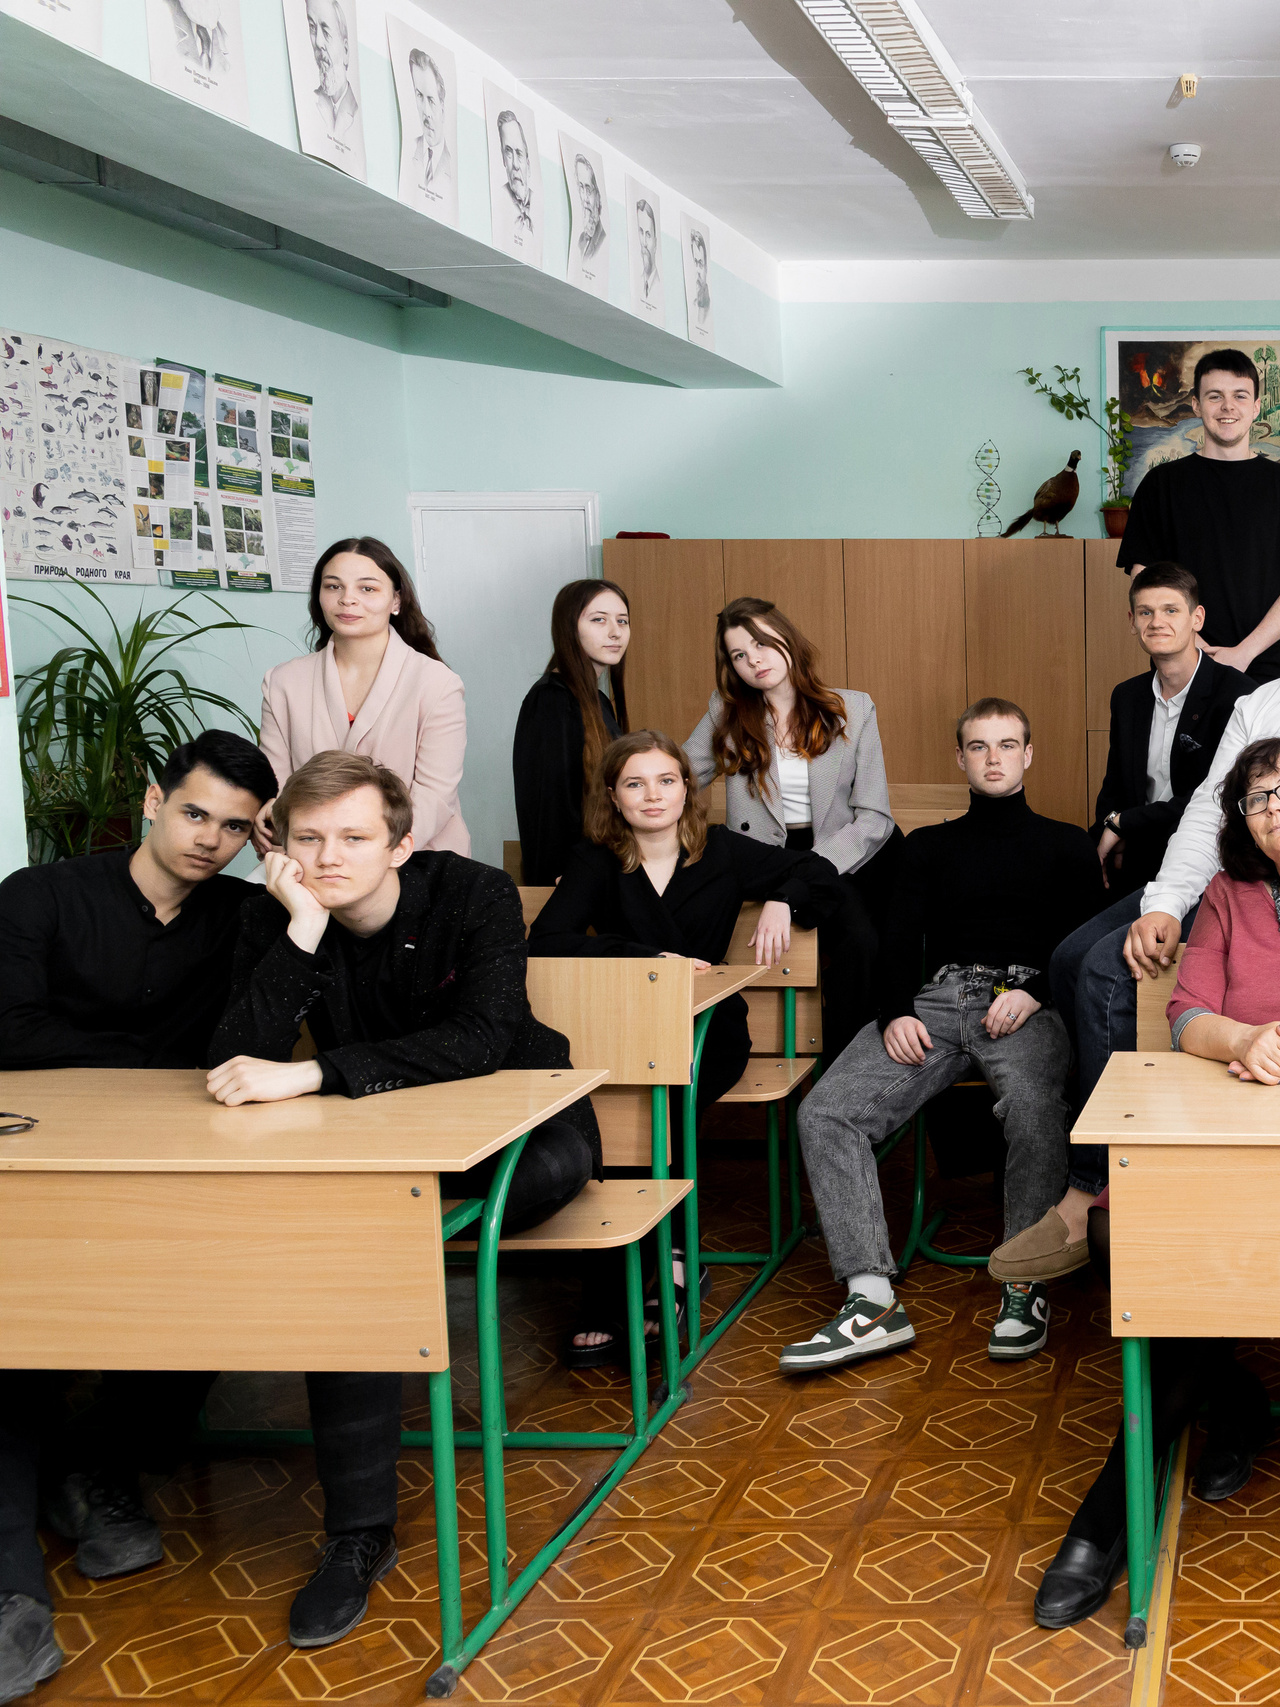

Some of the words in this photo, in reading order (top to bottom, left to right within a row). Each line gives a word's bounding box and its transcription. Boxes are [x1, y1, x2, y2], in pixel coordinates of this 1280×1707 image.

[34, 565, 69, 578] ПРИРОДА
[75, 567, 107, 578] РОДНОГО
[114, 570, 131, 580] КРАЯ
